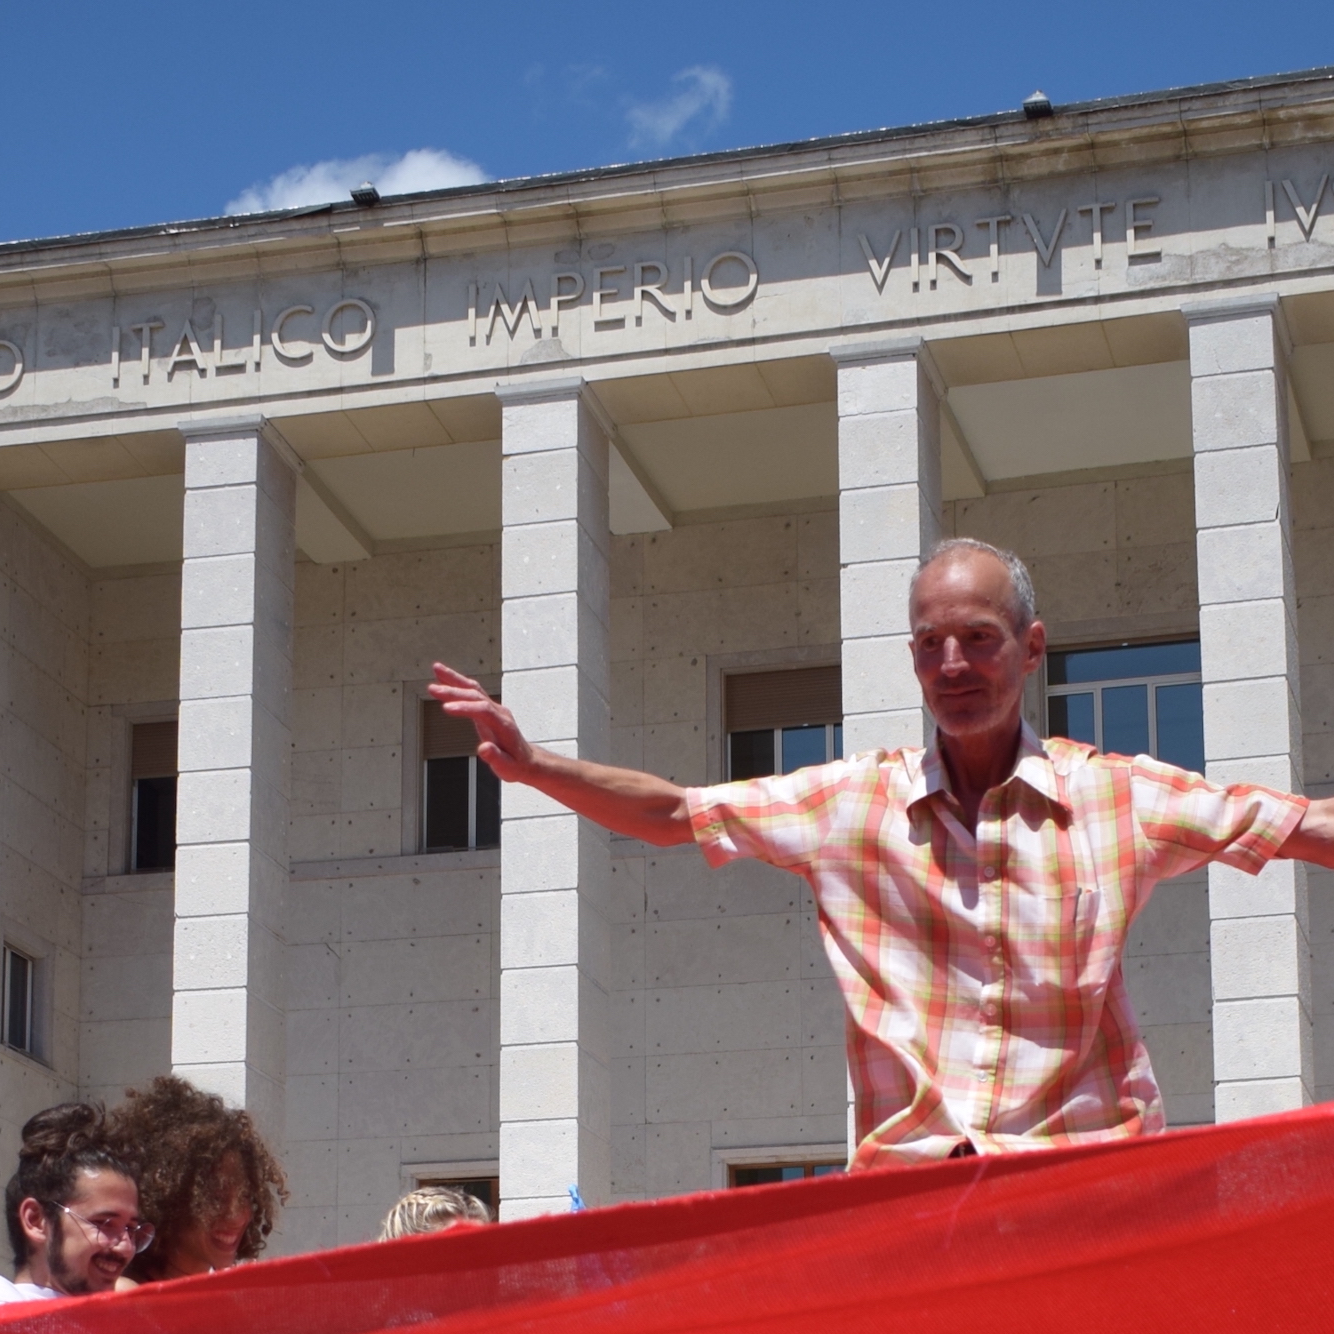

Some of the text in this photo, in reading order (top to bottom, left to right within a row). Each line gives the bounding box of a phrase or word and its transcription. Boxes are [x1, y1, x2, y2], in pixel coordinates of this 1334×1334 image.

[111, 298, 376, 385] ITALICO
[468, 251, 759, 344] IMPERIO
[857, 197, 1163, 291] VIRTVTE
